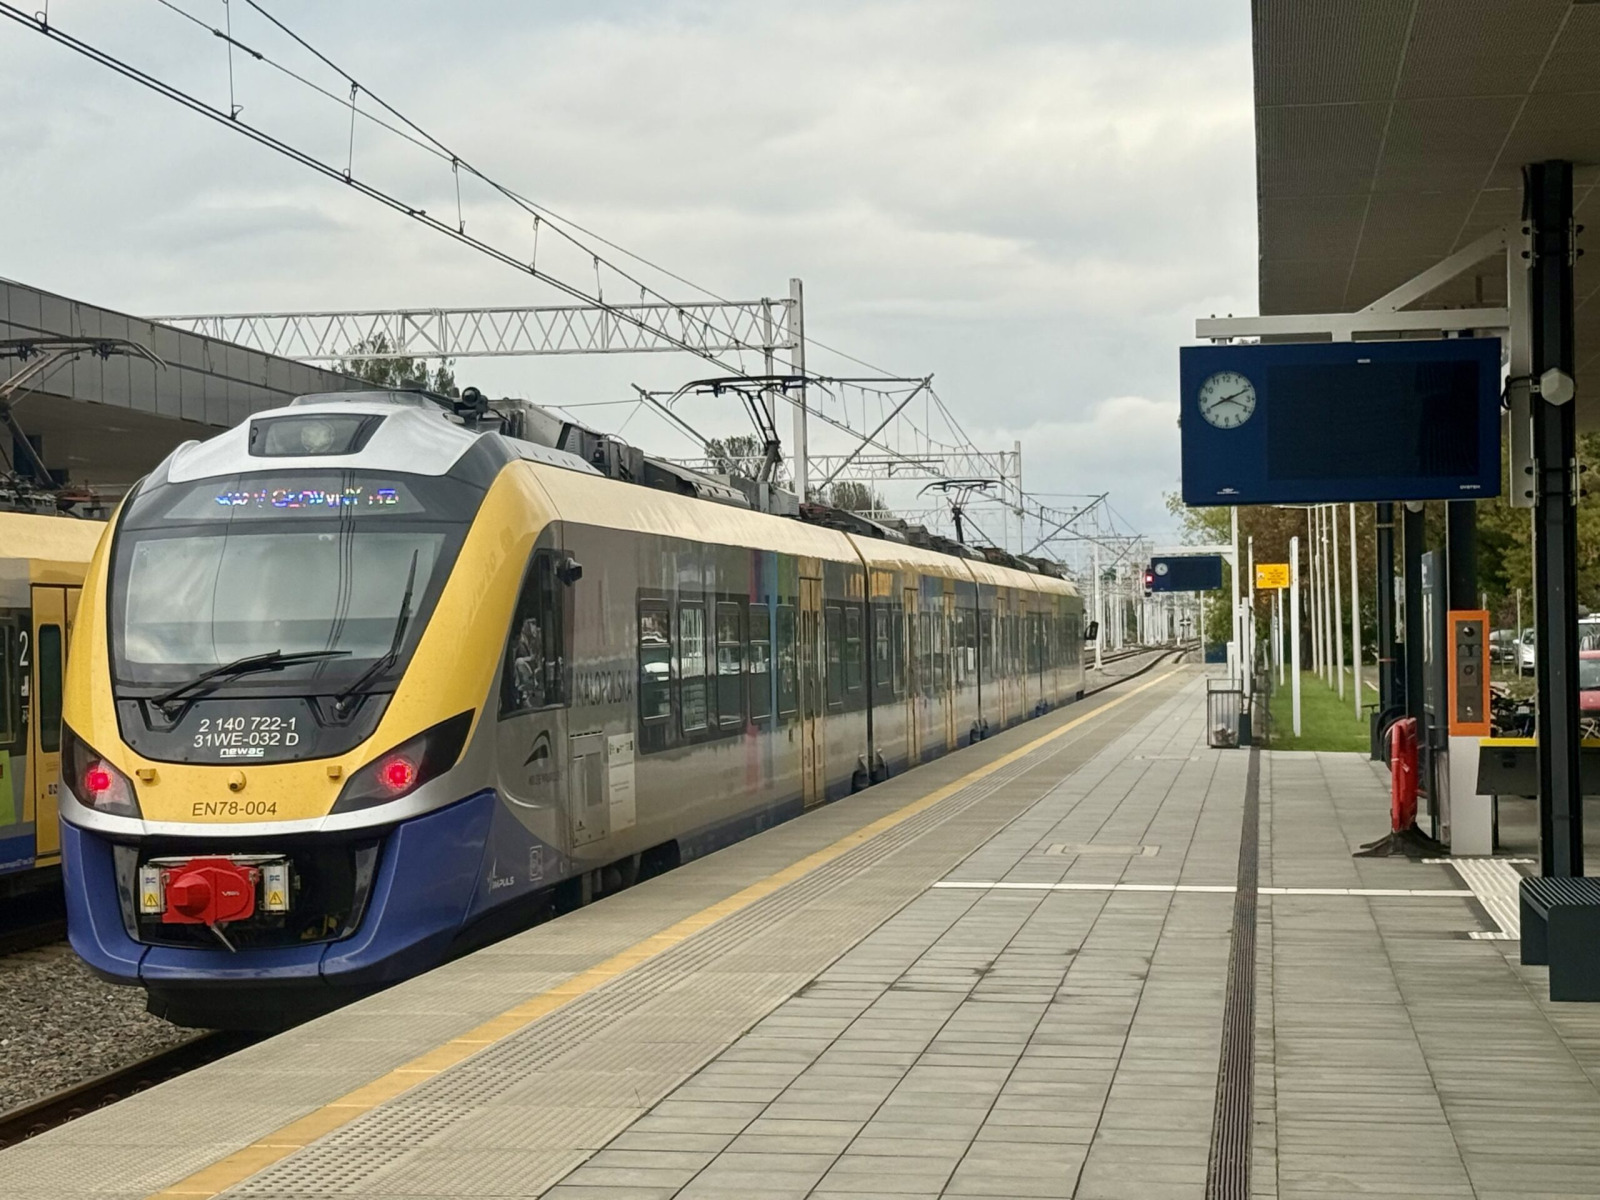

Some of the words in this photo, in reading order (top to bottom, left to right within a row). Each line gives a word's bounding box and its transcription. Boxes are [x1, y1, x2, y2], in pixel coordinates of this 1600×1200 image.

[19, 631, 29, 666] 2
[199, 719, 210, 732] 2
[216, 717, 245, 731] 140
[250, 717, 297, 730] 722-1
[193, 732, 281, 748] 31WE-032
[285, 733, 299, 746] D
[192, 801, 278, 817] EN78-004
